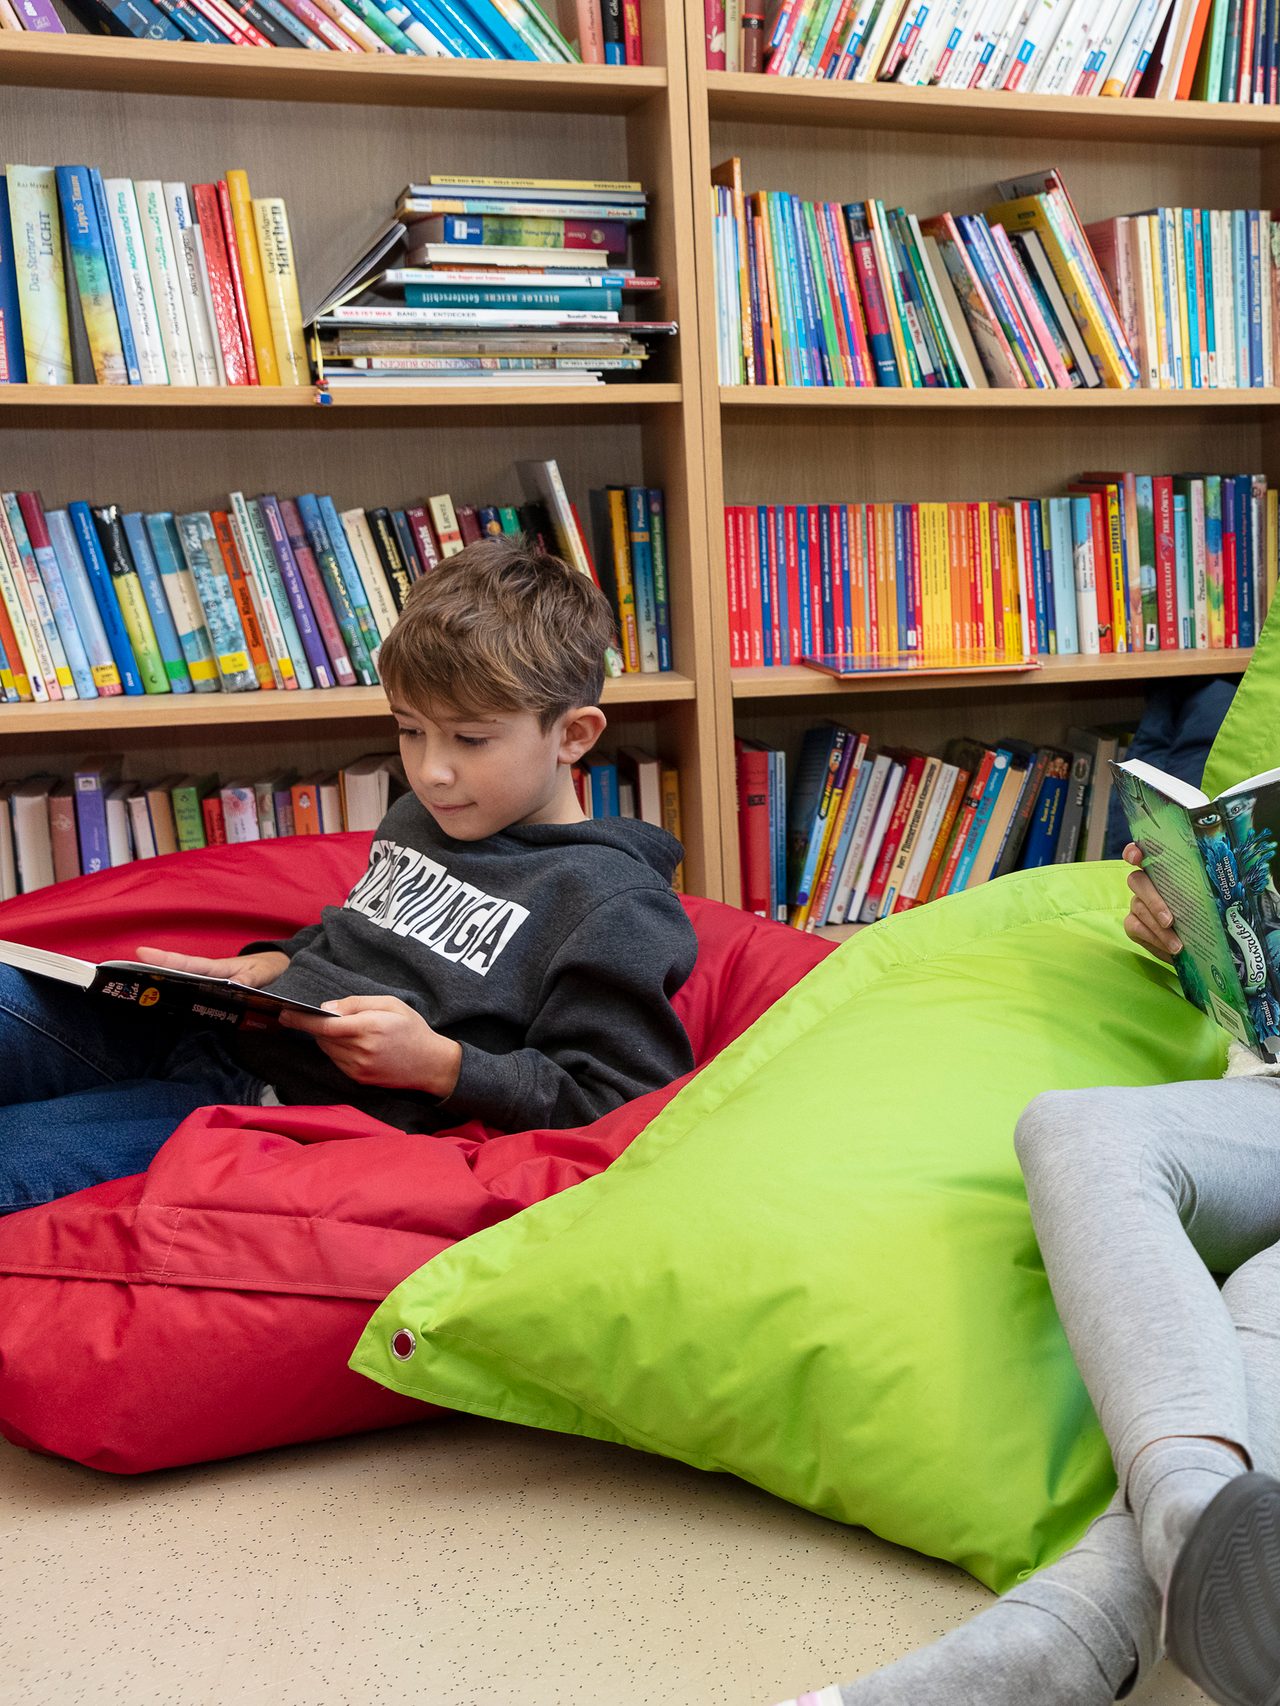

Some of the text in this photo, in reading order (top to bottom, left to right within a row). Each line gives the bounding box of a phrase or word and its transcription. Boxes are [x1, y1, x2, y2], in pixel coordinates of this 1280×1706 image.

[38, 211, 53, 257] LICHT
[272, 205, 291, 275] Märchen
[234, 585, 252, 616] Klages
[1164, 561, 1174, 622] RENÉ GUILLOT
[244, 615, 260, 648] Simone
[1216, 862, 1231, 900] Gefährliche
[1223, 856, 1236, 888] Gestalten
[1230, 911, 1264, 983] Seawalkers
[102, 981, 116, 995] Die
[110, 982, 125, 998] drei
[126, 982, 141, 1001] Kids
[1261, 1000, 1274, 1026] Brandis
